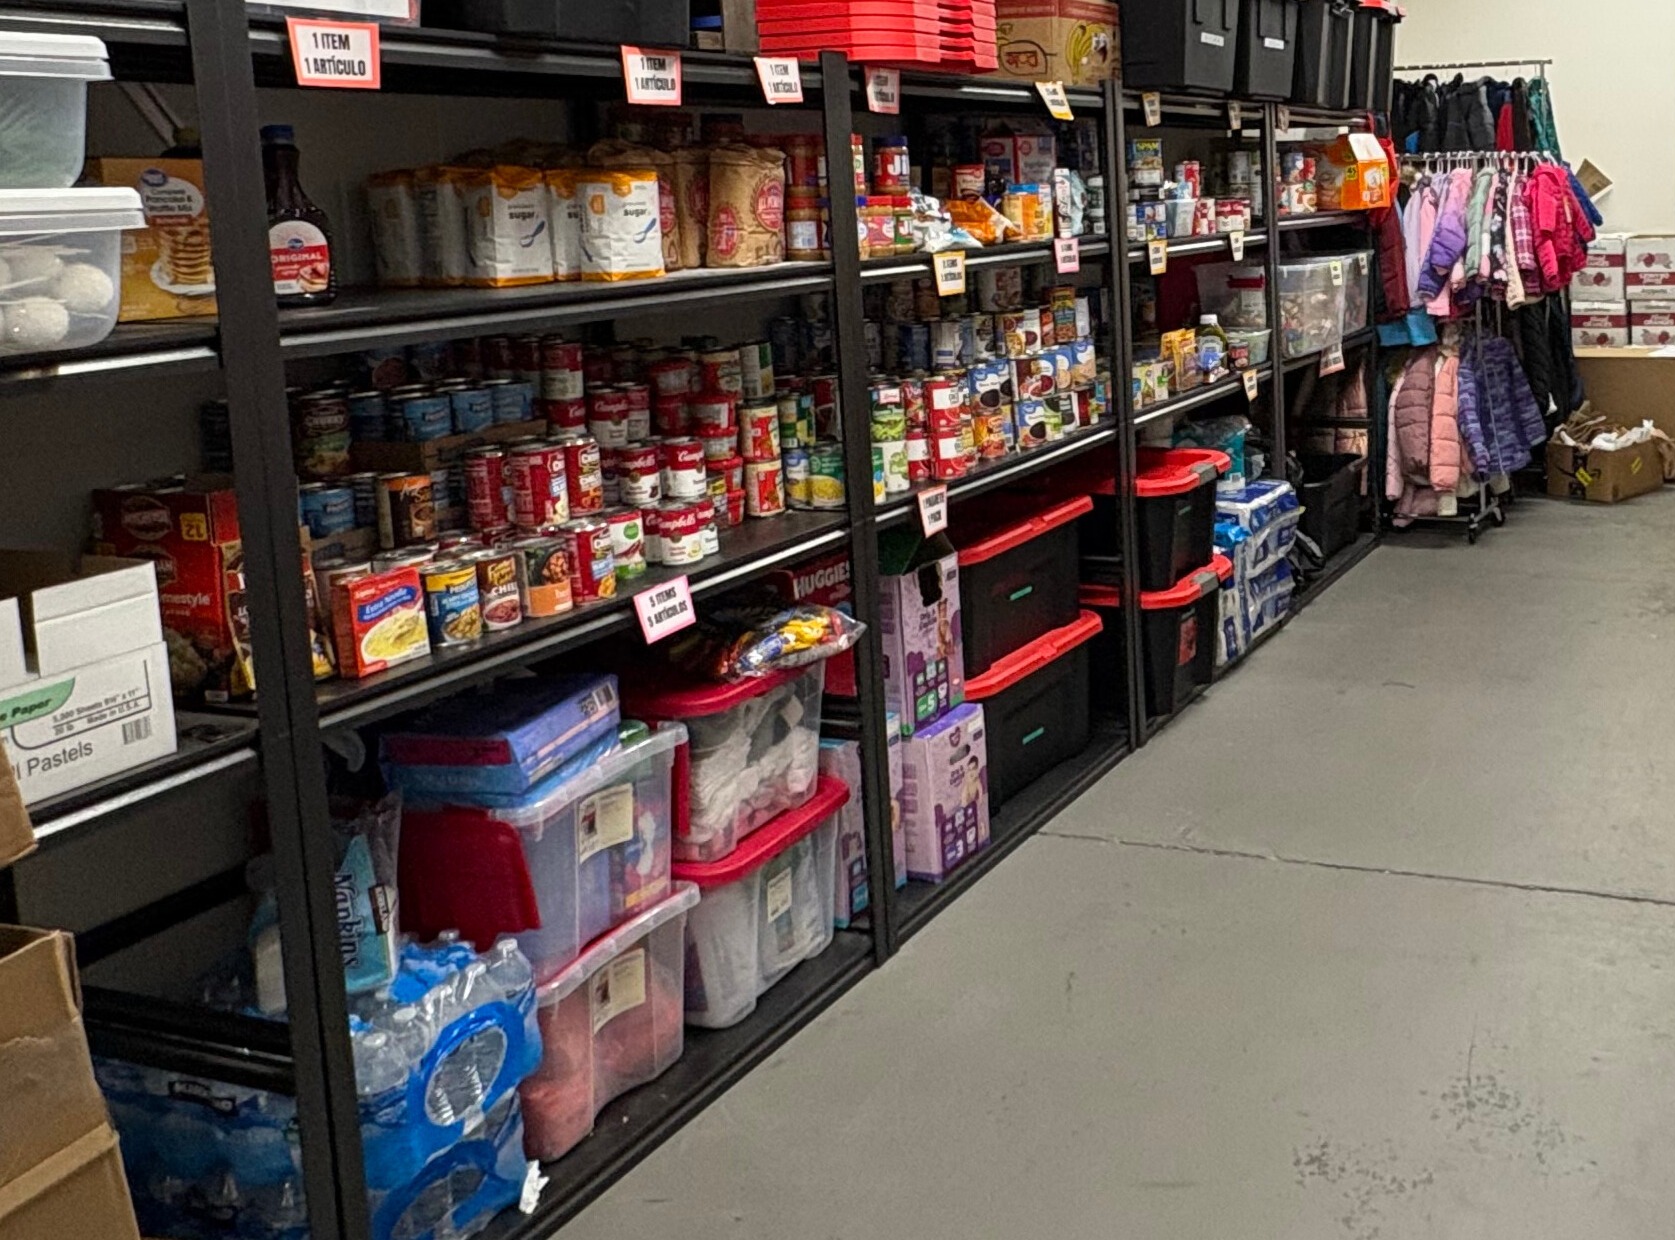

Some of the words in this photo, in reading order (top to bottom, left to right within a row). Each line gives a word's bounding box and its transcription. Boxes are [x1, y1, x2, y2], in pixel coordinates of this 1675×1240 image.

[312, 32, 319, 49] 1
[321, 33, 351, 51] ITEM
[304, 57, 311, 74] 1
[313, 55, 367, 76] ARTÍCULO
[648, 58, 667, 72] ITEM
[641, 74, 676, 92] ARTÍCULO
[887, 153, 909, 175] Ji
[622, 207, 648, 218] sugar
[271, 252, 323, 264] ORIGINAL
[793, 559, 851, 600] HUGGIES
[656, 586, 677, 605] ITEMS
[654, 600, 688, 625] ARTÍCULOS
[11, 698, 52, 718] Paper
[27, 741, 94, 776] Pastels
